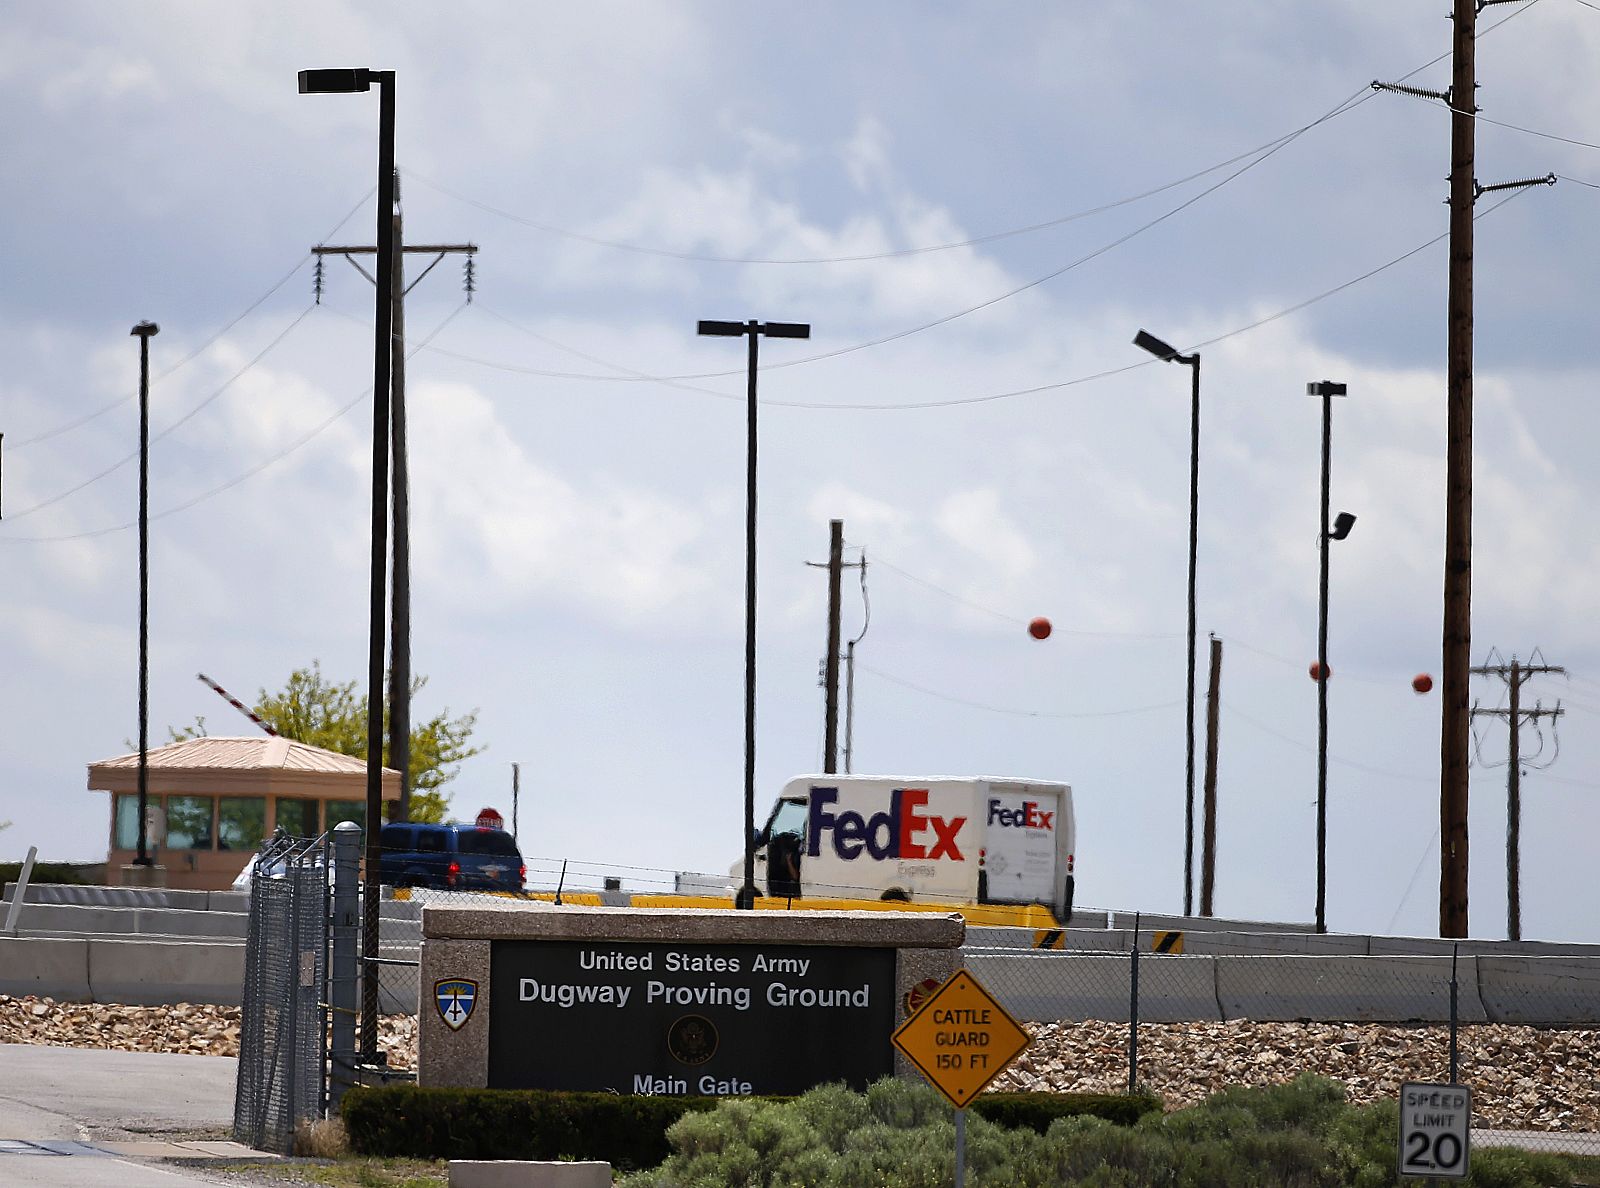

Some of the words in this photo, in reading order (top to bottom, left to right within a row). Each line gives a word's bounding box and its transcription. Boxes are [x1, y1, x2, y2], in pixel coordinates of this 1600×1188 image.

[807, 785, 967, 861] FedEx
[987, 799, 1055, 831] FedEx
[580, 950, 653, 971] United
[665, 952, 740, 973] States
[752, 953, 811, 977] Army
[519, 977, 632, 1008] Dugway
[647, 980, 751, 1011] Proving
[766, 982, 870, 1008] Ground
[933, 1009, 991, 1025] CATTLE
[935, 1032, 990, 1047] GUARD
[936, 1054, 962, 1069] 150
[970, 1054, 989, 1069] FT
[633, 1074, 687, 1095] Main
[698, 1075, 753, 1095] Gate
[1407, 1091, 1465, 1110] SPEED
[1413, 1113, 1455, 1127] LIMIT
[1406, 1131, 1463, 1169] 20
